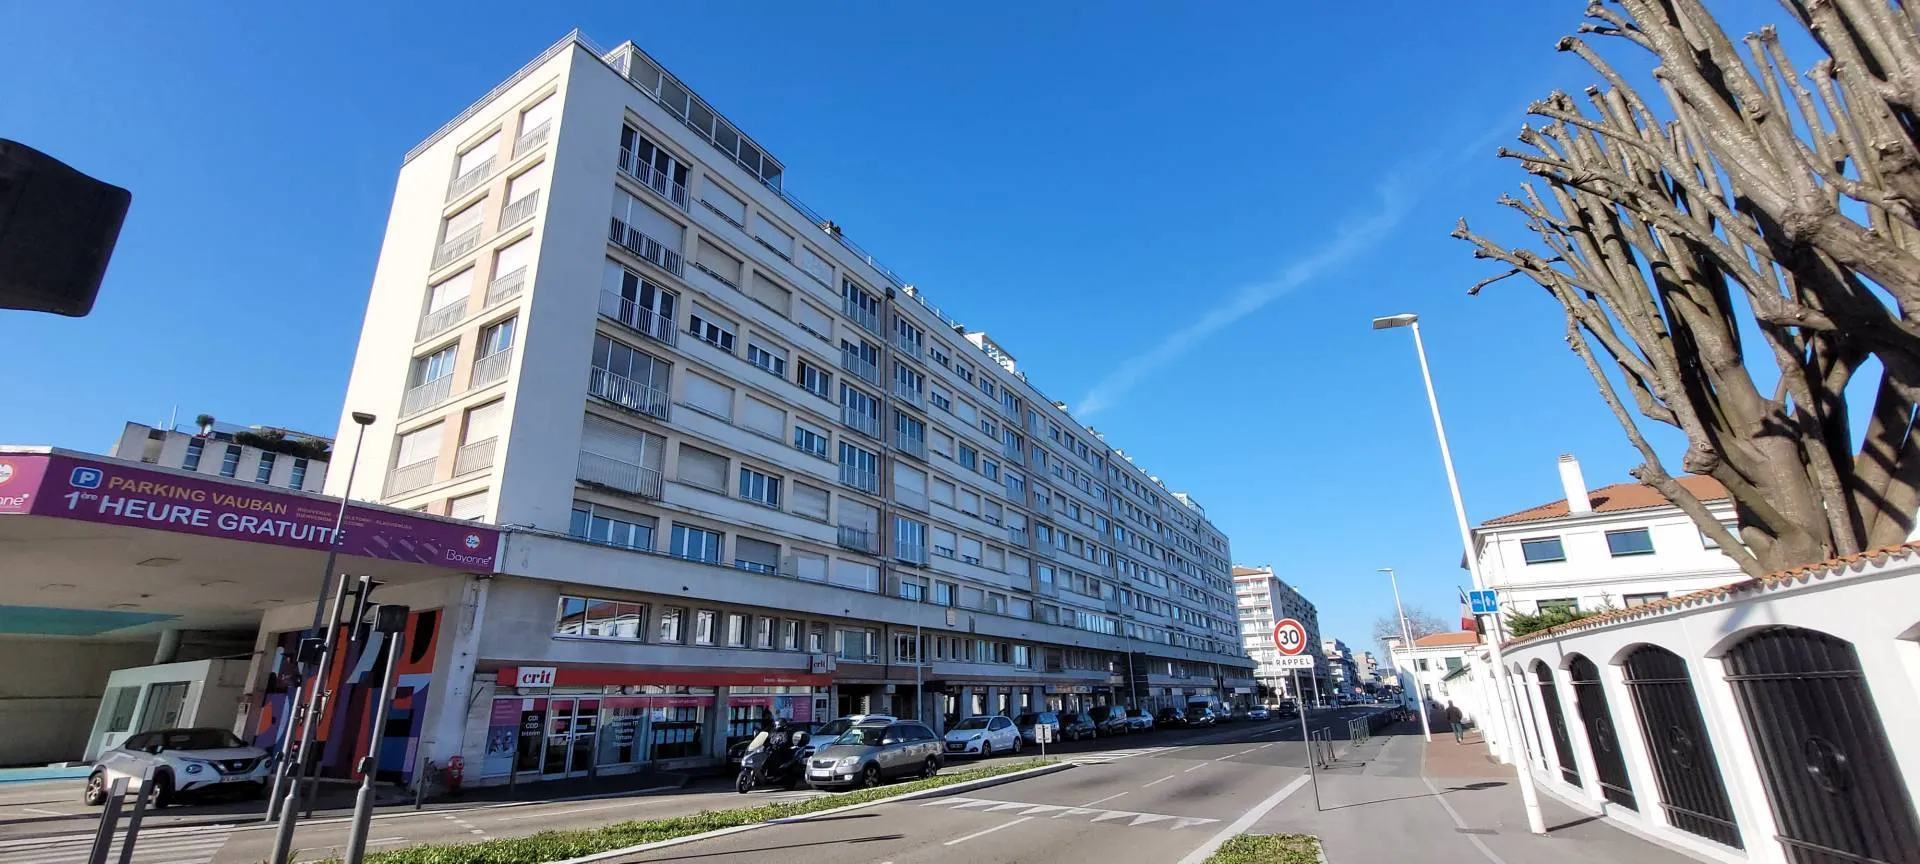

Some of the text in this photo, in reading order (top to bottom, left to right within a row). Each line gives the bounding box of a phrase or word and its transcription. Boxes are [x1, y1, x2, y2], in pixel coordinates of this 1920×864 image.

[79, 471, 96, 484] P
[108, 476, 287, 516] PARKING VAUBAN
[99, 494, 212, 527] HEURE
[217, 512, 346, 546] GRATUITE
[446, 549, 490, 565] Bayonne
[1279, 630, 1300, 645] 30
[1276, 658, 1311, 666] RAPPEL
[522, 669, 551, 684] crit
